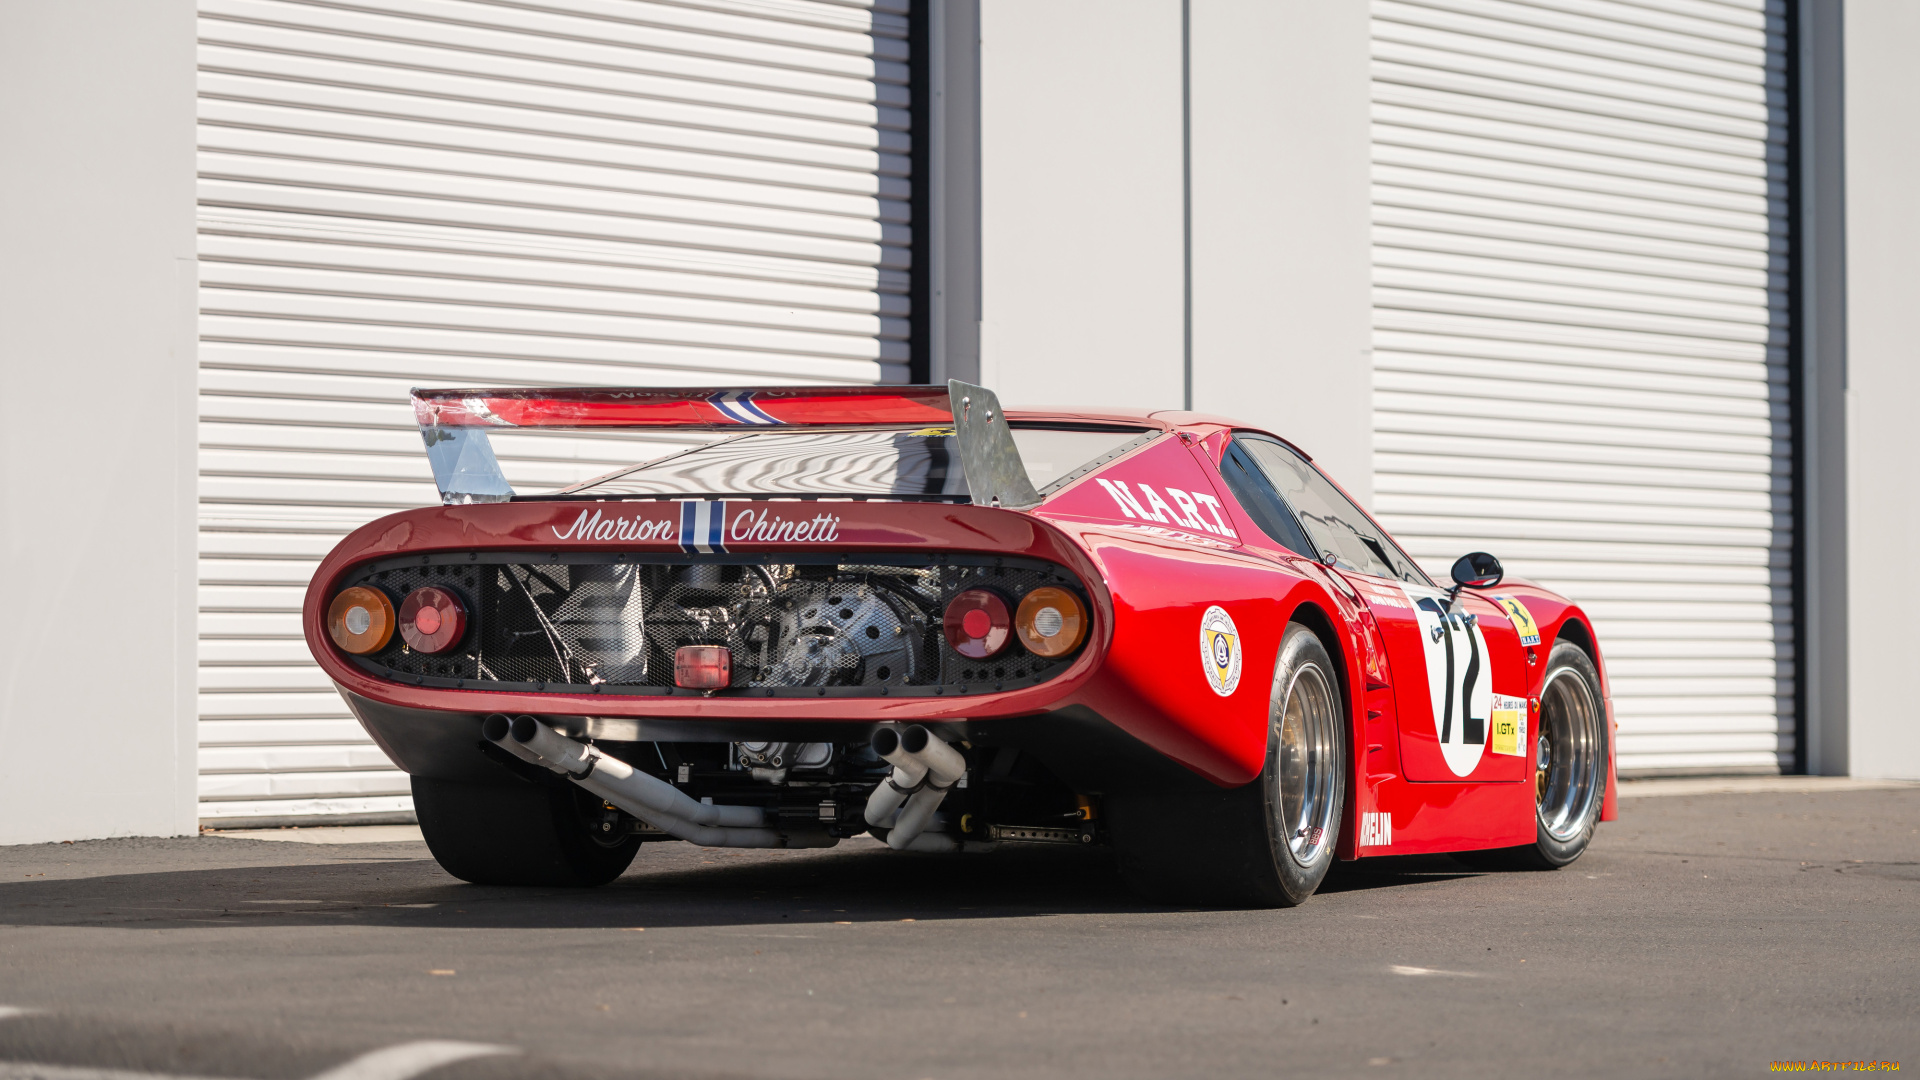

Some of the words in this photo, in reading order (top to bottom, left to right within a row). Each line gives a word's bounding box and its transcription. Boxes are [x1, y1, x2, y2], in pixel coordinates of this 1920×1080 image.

[552, 509, 674, 541] Marion
[731, 508, 840, 542] Chinetti
[1410, 594, 1484, 744] 72
[1494, 695, 1502, 709] 24
[1310, 827, 1322, 845] BBS
